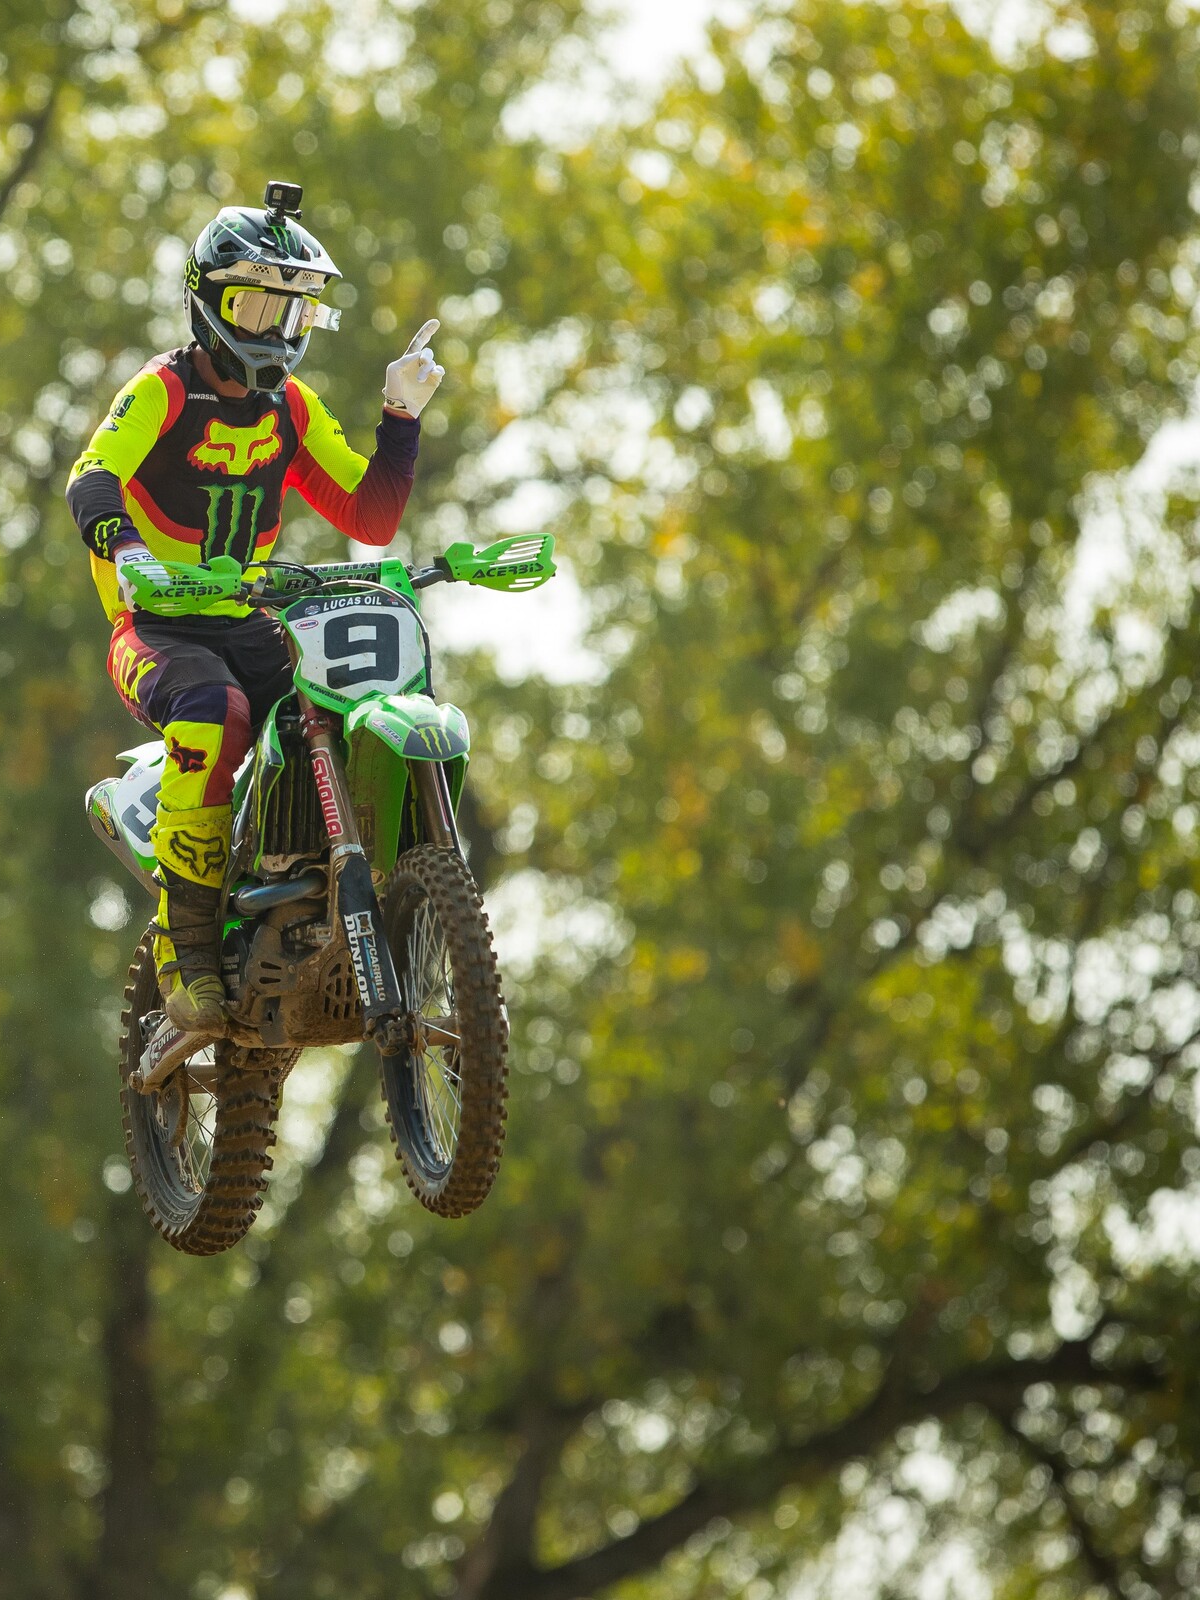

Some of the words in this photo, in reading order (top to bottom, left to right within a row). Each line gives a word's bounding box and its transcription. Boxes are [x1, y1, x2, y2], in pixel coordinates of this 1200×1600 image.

[471, 562, 545, 579] ACERBIS
[150, 585, 224, 598] ACERBIS
[323, 596, 361, 612] LUCAS
[364, 595, 382, 606] OIL
[323, 612, 400, 690] 9
[308, 682, 347, 705] Kawasaki
[311, 756, 344, 839] SHOWA
[343, 913, 371, 1007] DUNLOP
